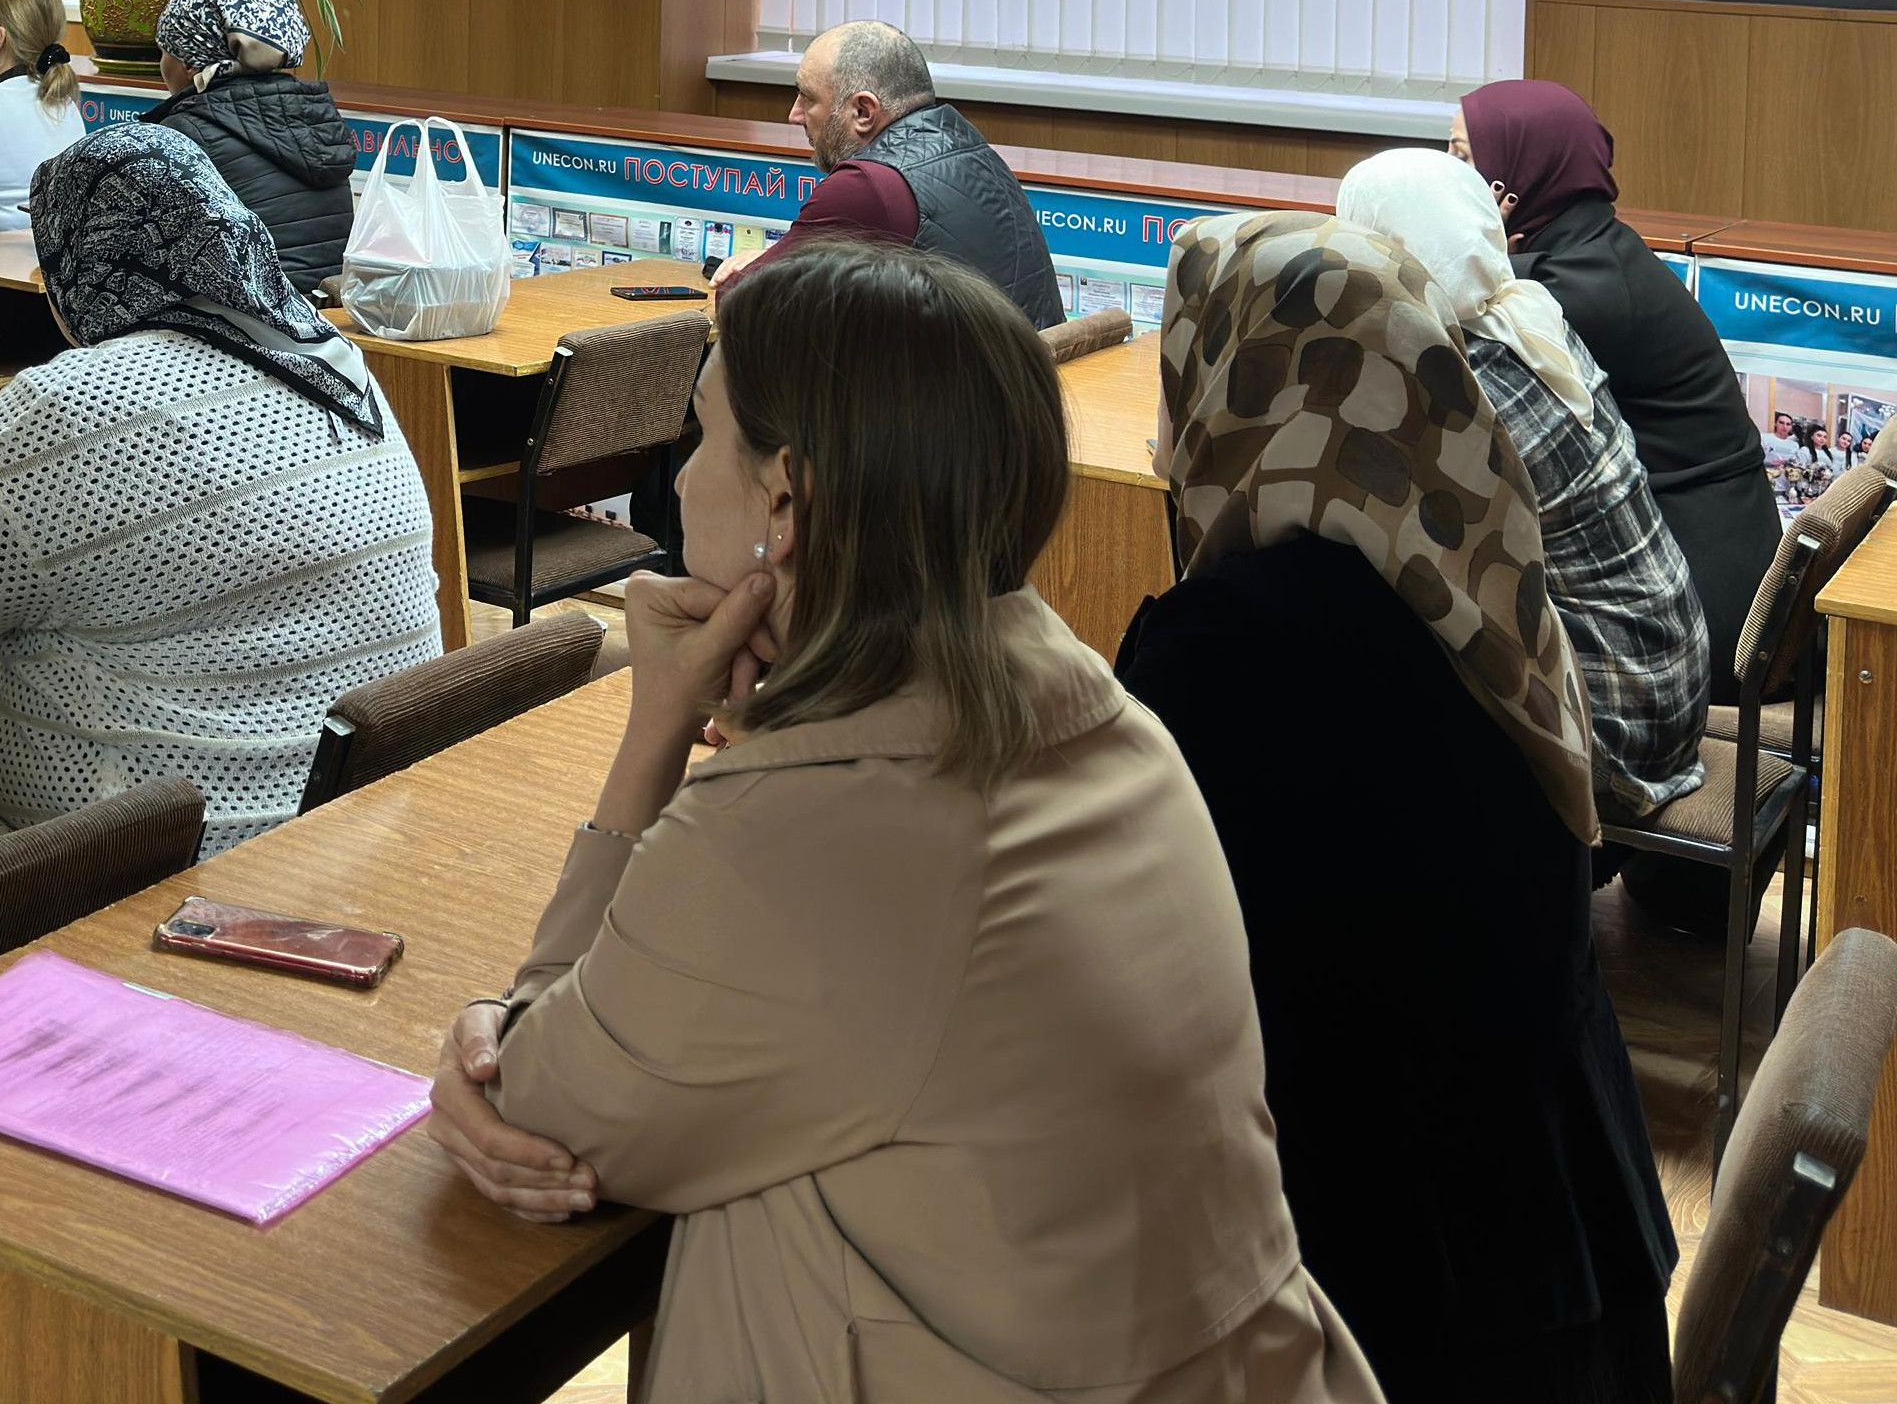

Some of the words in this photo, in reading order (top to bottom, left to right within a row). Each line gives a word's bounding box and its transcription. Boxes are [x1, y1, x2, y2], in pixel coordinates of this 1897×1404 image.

[532, 150, 617, 174] UNECON.RU
[624, 156, 786, 200] ПОСТУПАЙ
[1734, 291, 1881, 326] UNECON.RU
